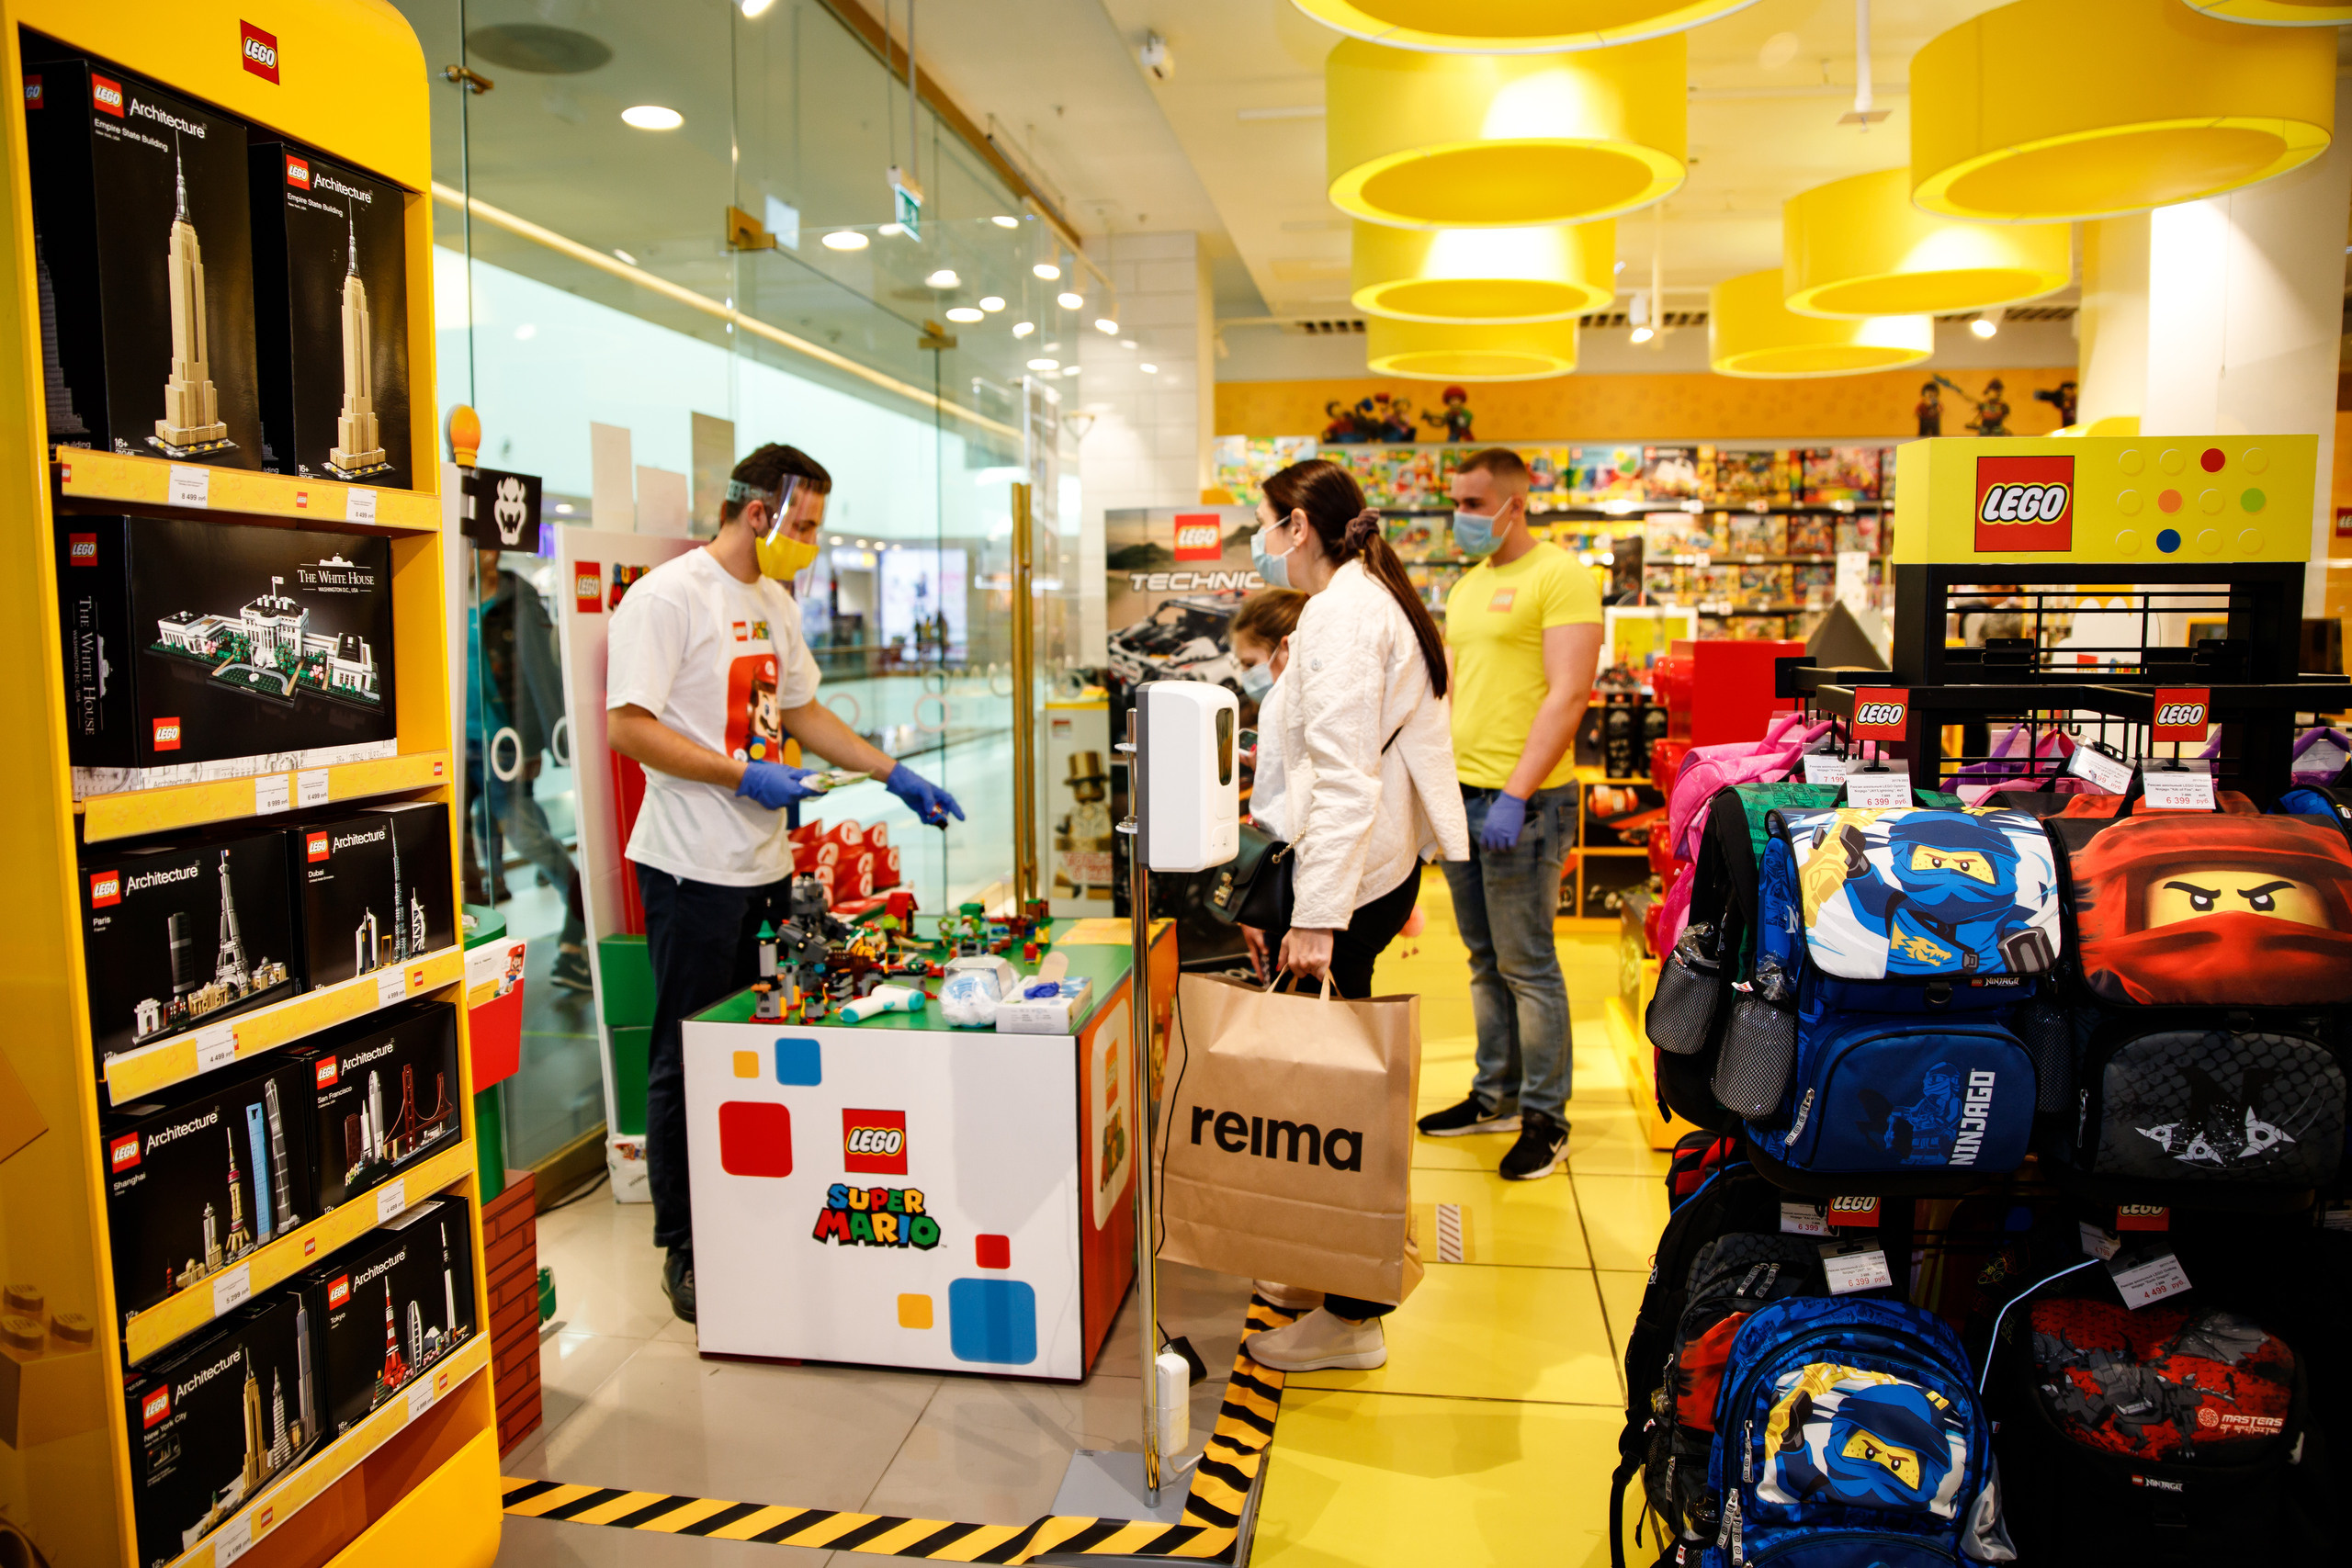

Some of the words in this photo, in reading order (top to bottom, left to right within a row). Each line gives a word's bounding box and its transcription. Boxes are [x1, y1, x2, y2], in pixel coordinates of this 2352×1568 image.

[243, 38, 277, 68] LEGO
[25, 85, 40, 99] GO
[95, 85, 120, 106] LEGO
[130, 98, 206, 139] Architecture
[94, 118, 120, 134] Empire
[122, 127, 140, 141] State
[141, 134, 168, 152] Building
[288, 165, 307, 180] LEGO
[314, 173, 371, 203] Architecture
[287, 193, 307, 205] Empire
[308, 198, 322, 209] State
[322, 204, 343, 218] Building
[115, 437, 129, 448] 16+
[299, 464, 310, 473] 16+
[1983, 487, 2066, 521] LEGO
[1177, 527, 1218, 547] LEGO
[72, 543, 95, 557] LEGO
[298, 570, 317, 583] THE
[318, 570, 346, 584] WHITE
[348, 571, 375, 585] HOUSE
[577, 577, 600, 597] LEGO
[1129, 571, 1266, 592] TECHNIC
[80, 596, 92, 627] THE
[81, 632, 95, 682] WHITE
[83, 686, 96, 735] HOUSE
[1858, 705, 1904, 725] LEGO
[2158, 705, 2204, 725] LEGO
[155, 727, 178, 741] LEGO
[2166, 796, 2172, 805] 6
[2174, 796, 2190, 805] 399
[310, 840, 327, 853] LEGO
[333, 830, 385, 854] Architecture
[126, 866, 198, 897] Architecture
[308, 869, 324, 878] Dubai
[94, 882, 118, 897] LEGO
[93, 916, 111, 927] Paris
[1984, 977, 2020, 987] NINJAGO
[341, 1043, 393, 1077] Architecture
[318, 1065, 335, 1081] LEGO
[317, 1093, 328, 1103] San
[329, 1086, 353, 1100] Francisco
[1949, 1070, 1996, 1166] NINJAGO
[146, 1112, 218, 1156] Architecture
[848, 1129, 903, 1155] LEGO
[1191, 1105, 1363, 1173] reima
[114, 1143, 137, 1163] LEGO
[113, 1172, 146, 1191] Shanghai
[827, 1183, 926, 1215] SUPER
[1833, 1195, 1877, 1212] LEGO
[813, 1208, 941, 1251] MARIO
[353, 1251, 406, 1293] Architecture
[1856, 1277, 1870, 1286] 399
[1874, 1275, 1887, 1283] руб.
[331, 1283, 347, 1301] LEGO
[2152, 1285, 2167, 1297] 499
[331, 1313, 346, 1325] Tokyo
[175, 1350, 241, 1406] Architecture
[145, 1395, 167, 1418] LEGO
[143, 1429, 159, 1443] New
[160, 1419, 174, 1431] York
[175, 1411, 187, 1424] City
[338, 1421, 347, 1430] 16+
[2222, 1414, 2284, 1427] MASTERS
[2144, 1477, 2184, 1493] NINJAGO
